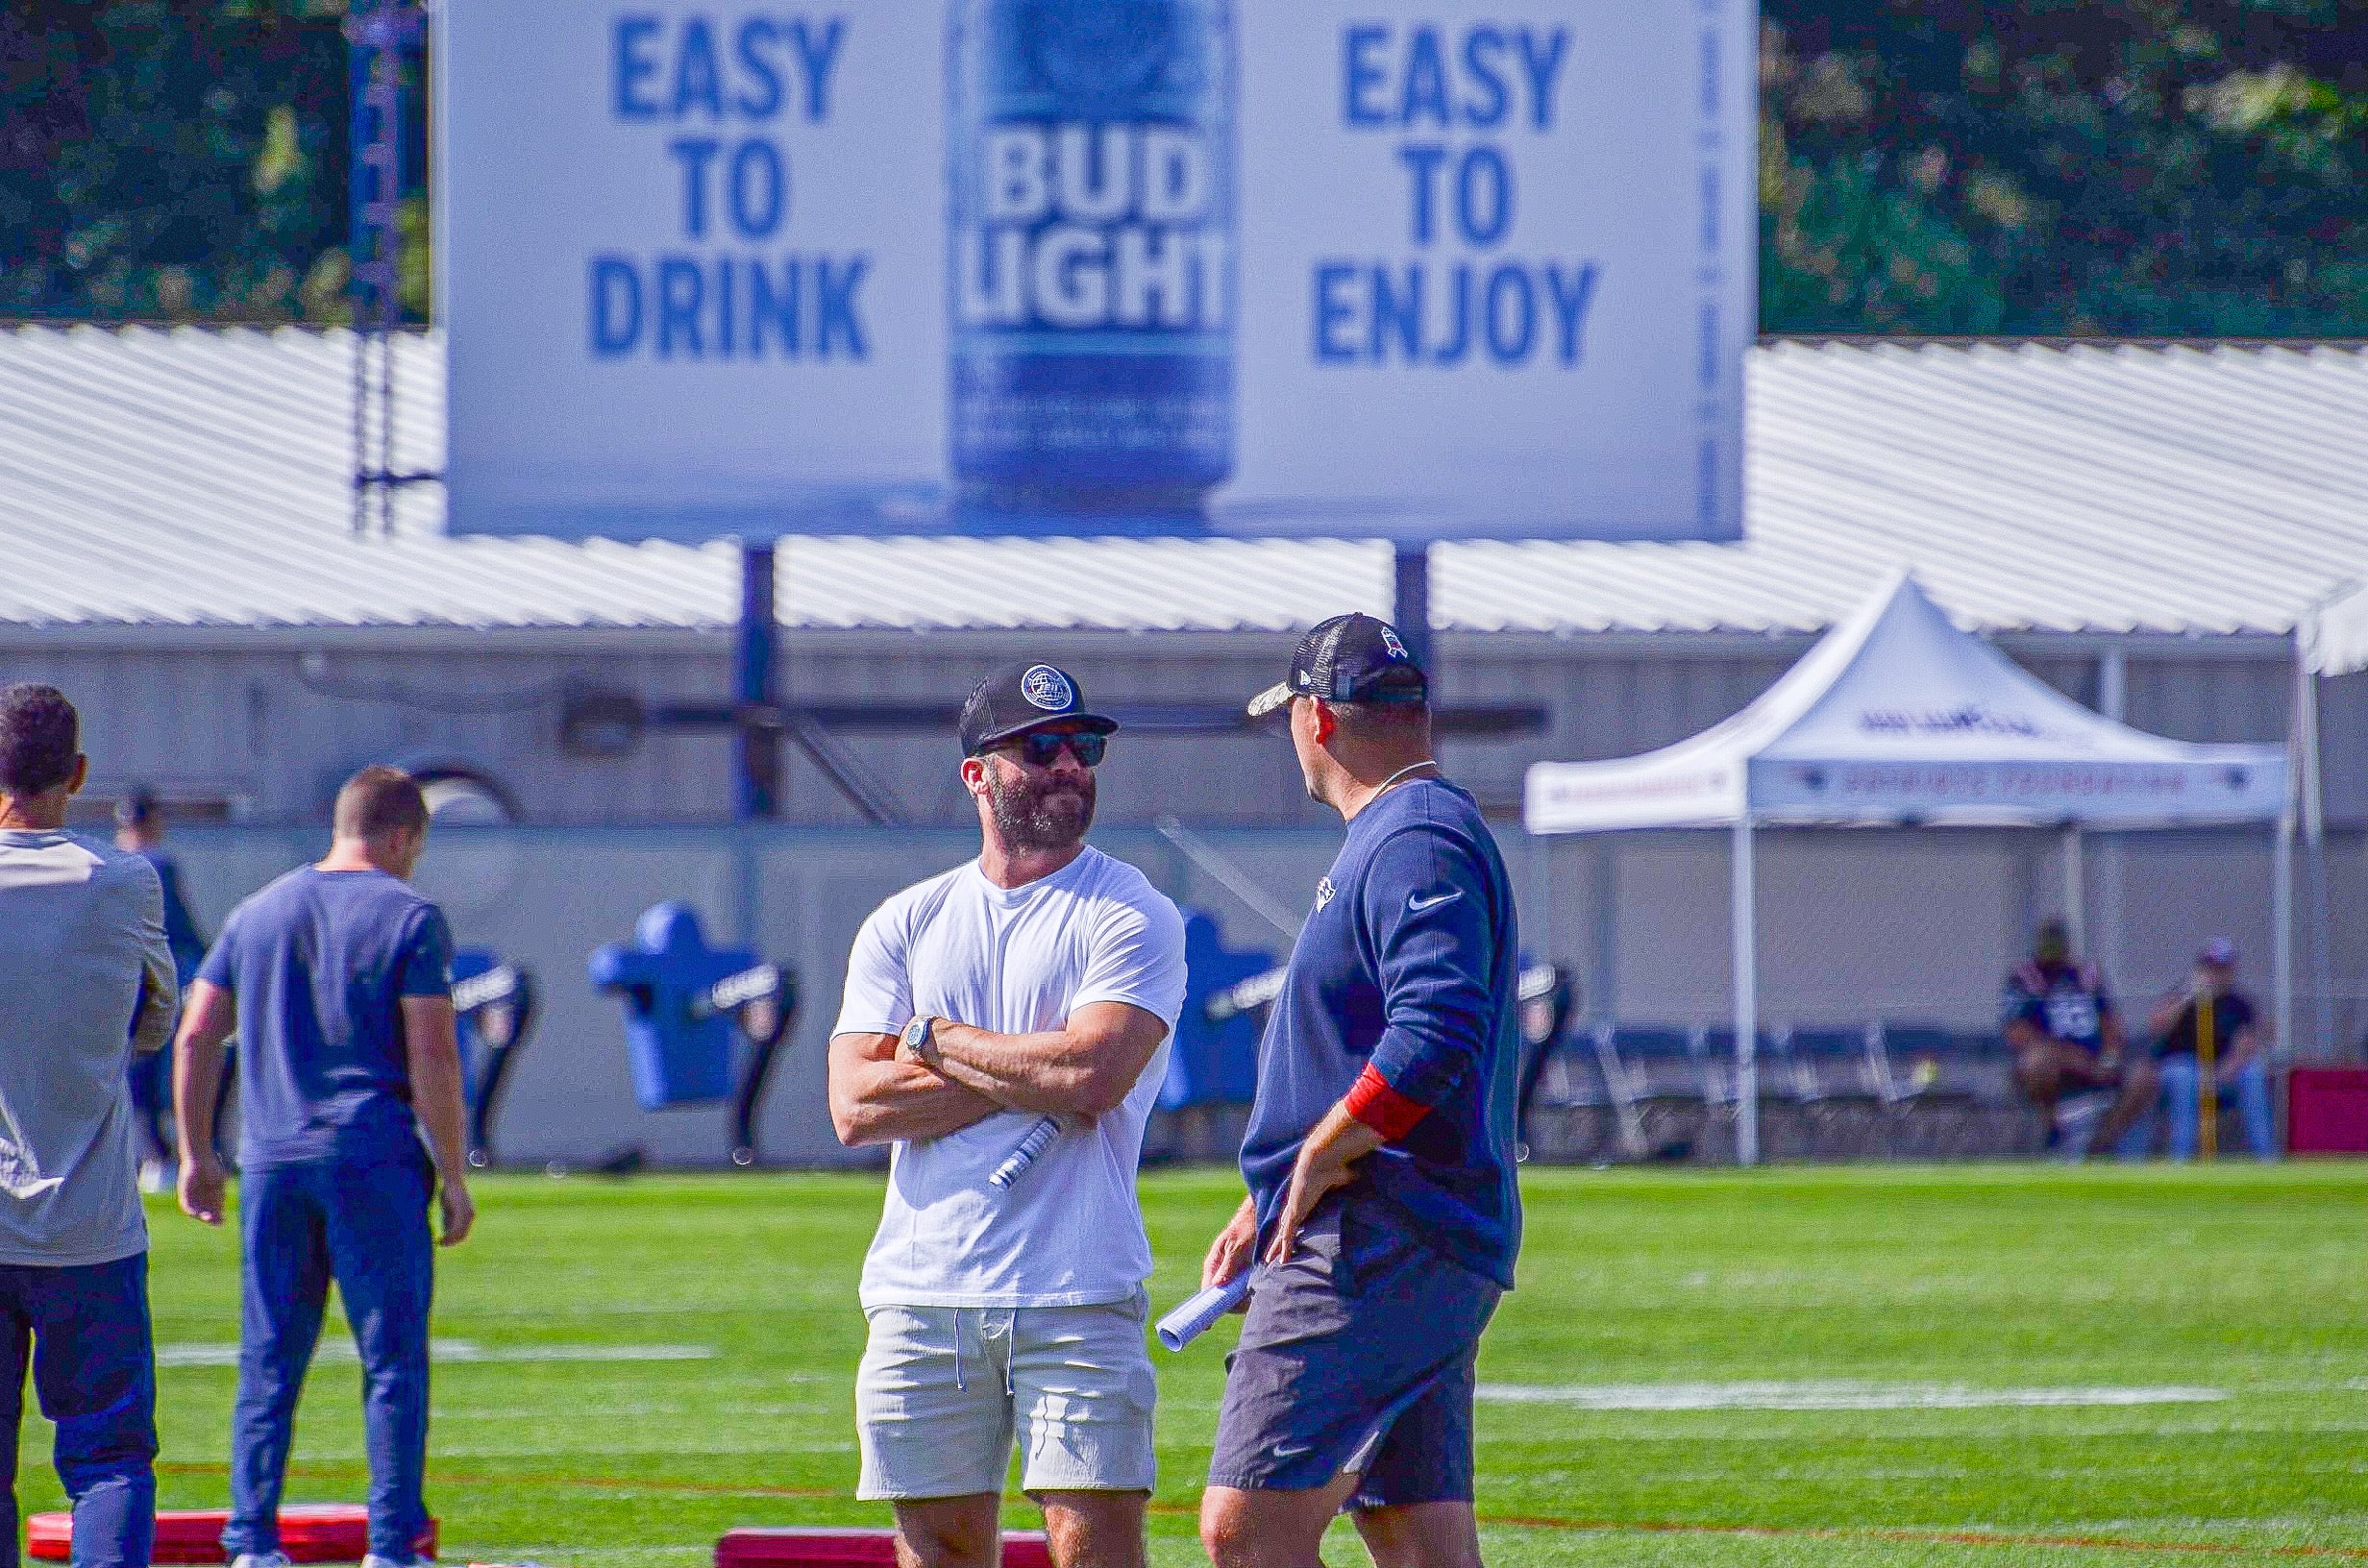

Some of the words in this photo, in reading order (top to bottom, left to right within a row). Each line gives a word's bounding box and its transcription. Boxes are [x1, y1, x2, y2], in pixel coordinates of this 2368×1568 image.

[613, 17, 845, 122] EASY
[1342, 23, 1572, 130] EASY
[670, 136, 788, 240] TO
[985, 123, 1208, 220] BUD
[1399, 144, 1515, 248] TO
[589, 255, 872, 361] DRINK
[960, 226, 1225, 327] LIGHT
[1312, 258, 1599, 368] ENJOY
